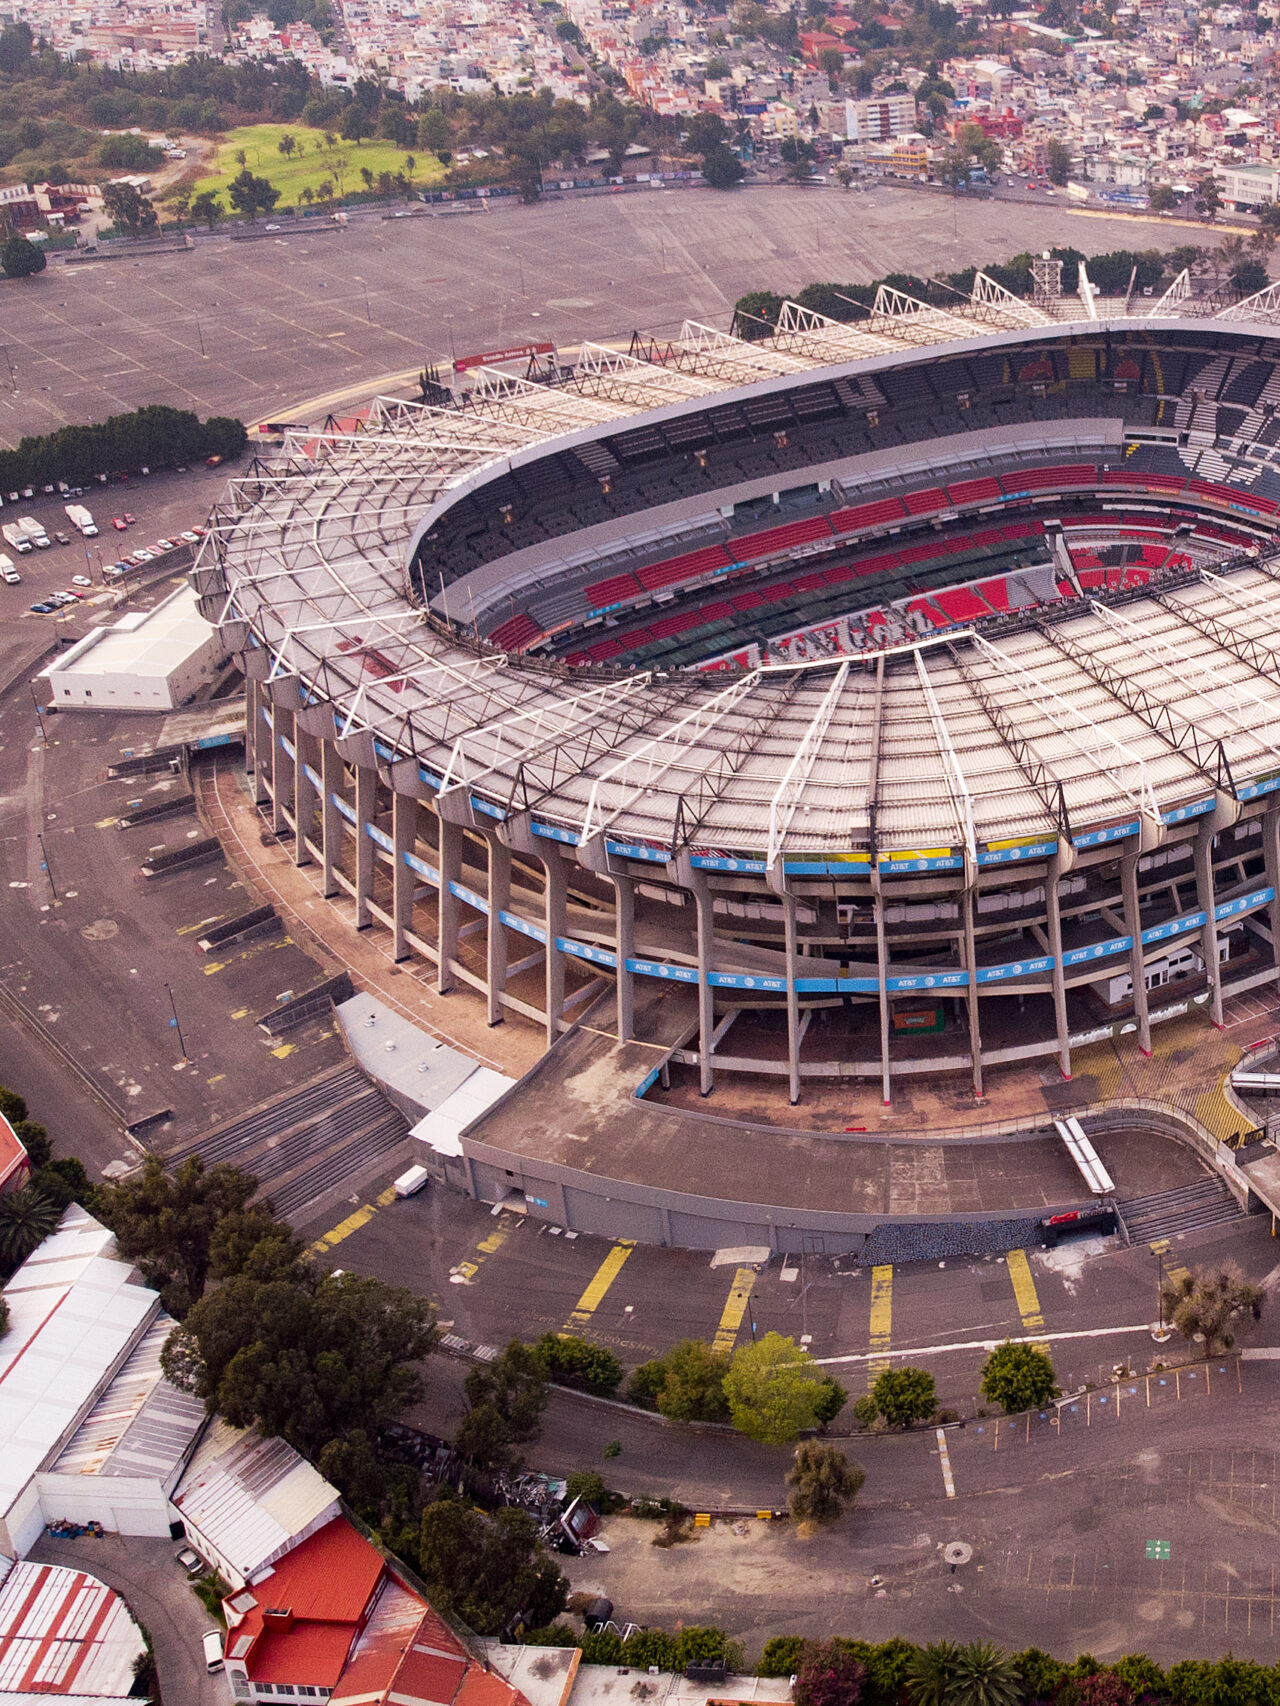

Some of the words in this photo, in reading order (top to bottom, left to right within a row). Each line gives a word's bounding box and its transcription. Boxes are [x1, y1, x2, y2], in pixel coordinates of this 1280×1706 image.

[1192, 804, 1207, 814] AT&T
[1114, 827, 1130, 837] AT&T
[615, 846, 632, 855] AT&T
[984, 854, 1003, 862] AT&T
[1028, 846, 1047, 855] AT&T
[745, 863, 764, 871] AT&T
[936, 859, 955, 867] AT&T
[1219, 905, 1234, 915] AT&T
[1252, 894, 1266, 903] AT&T
[1147, 930, 1164, 940] AT&T
[1185, 918, 1200, 927] AT&T
[1071, 952, 1088, 961] AT&T
[1110, 941, 1128, 950] AT&T
[598, 953, 613, 963] AT&T
[635, 964, 652, 972] AT&T
[675, 970, 692, 979] AT&T
[987, 969, 1005, 978] AT&T
[1029, 961, 1048, 970] AT&T
[718, 976, 737, 984] AT&T
[762, 980, 782, 988] AT&T
[898, 979, 917, 987] AT&T
[942, 976, 962, 984] AT&T
